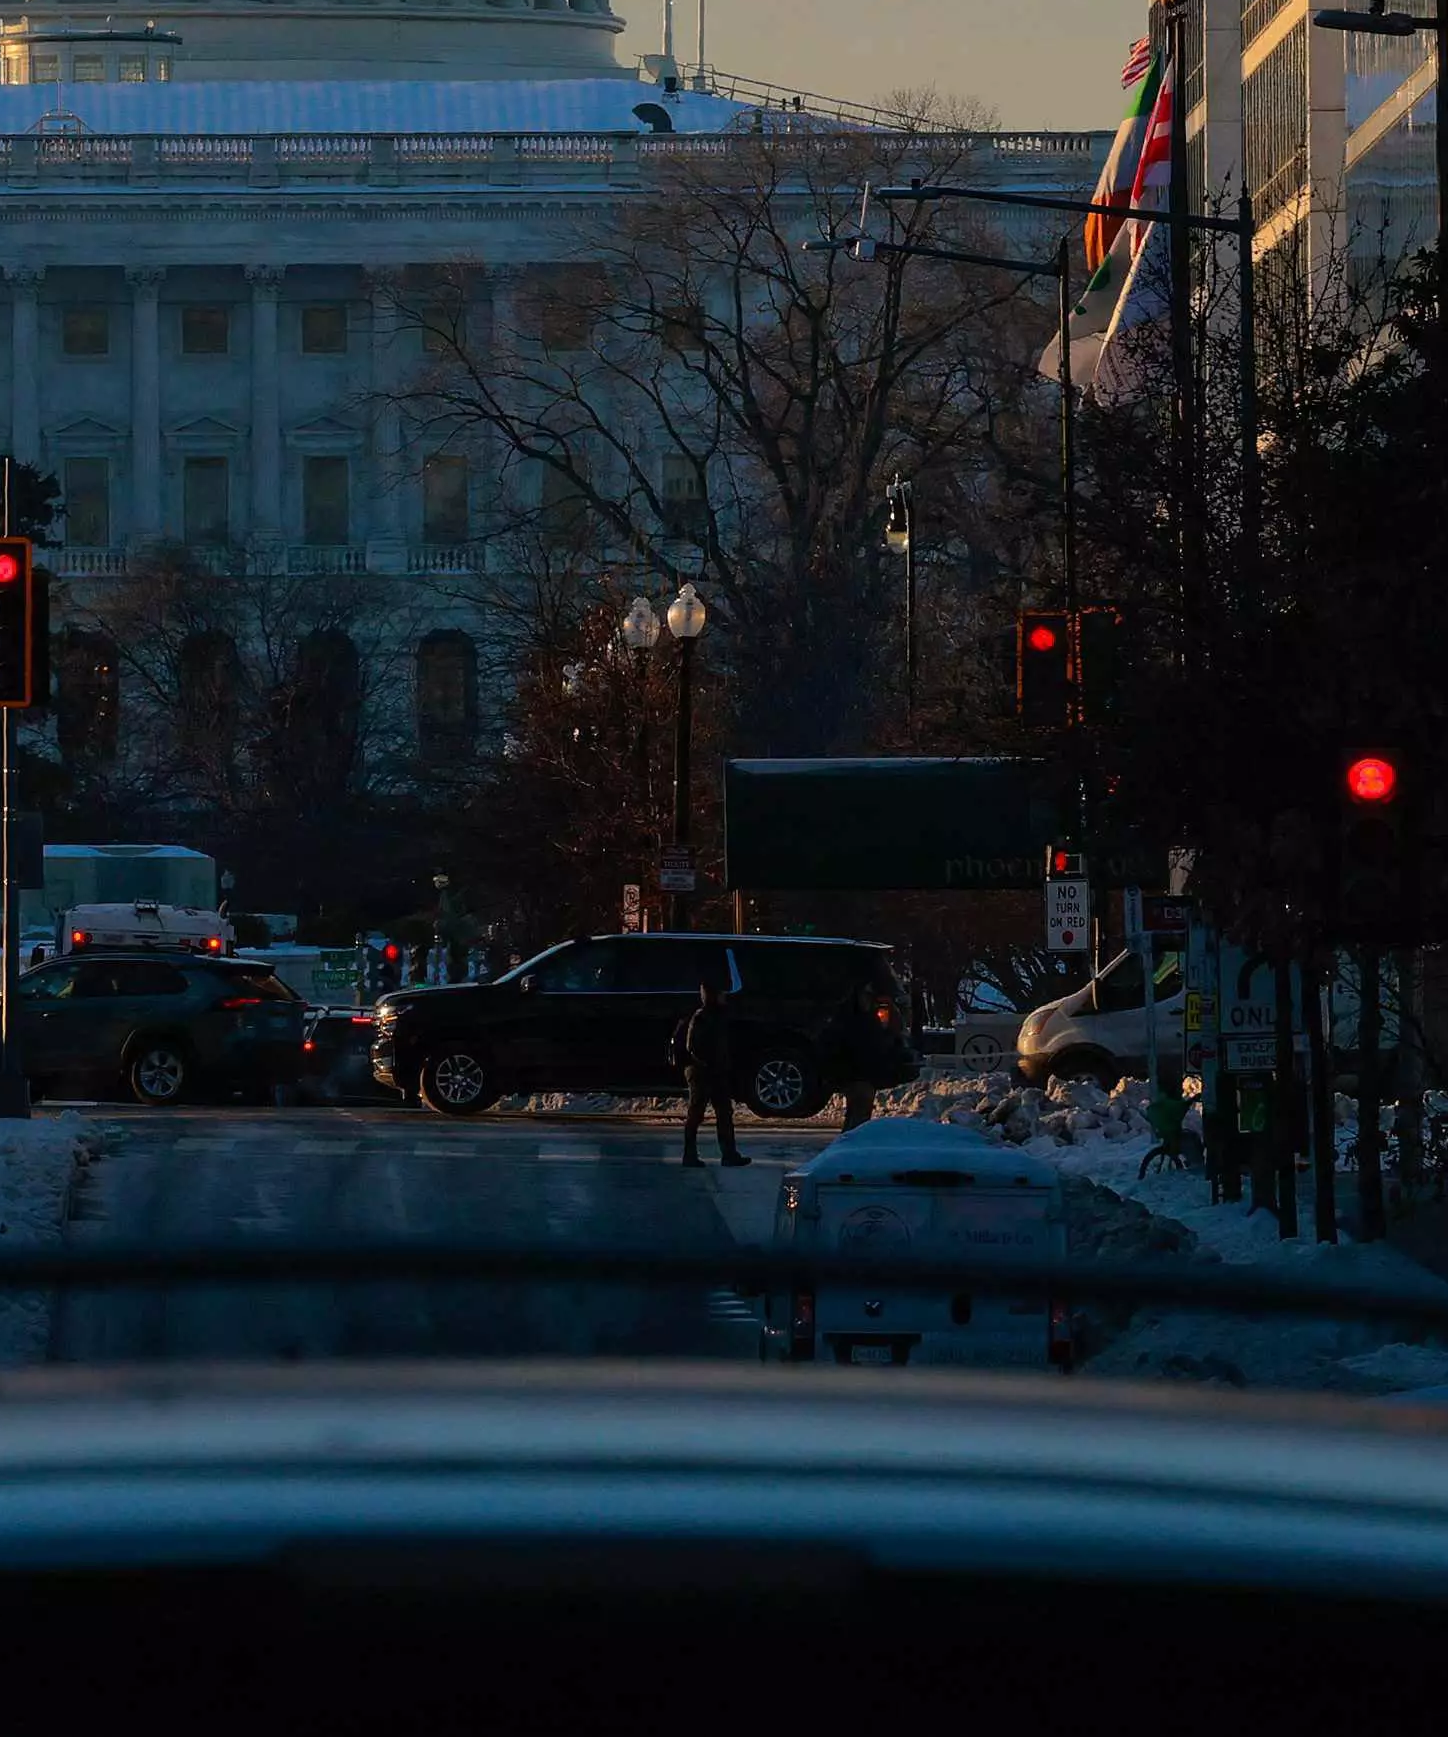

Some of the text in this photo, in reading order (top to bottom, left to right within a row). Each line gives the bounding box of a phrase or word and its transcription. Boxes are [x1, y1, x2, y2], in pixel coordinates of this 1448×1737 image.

[1057, 886, 1077, 899] NO
[1056, 903, 1080, 913] TURN
[1050, 917, 1085, 928] ON RED
[1230, 1006, 1277, 1028] ONL
